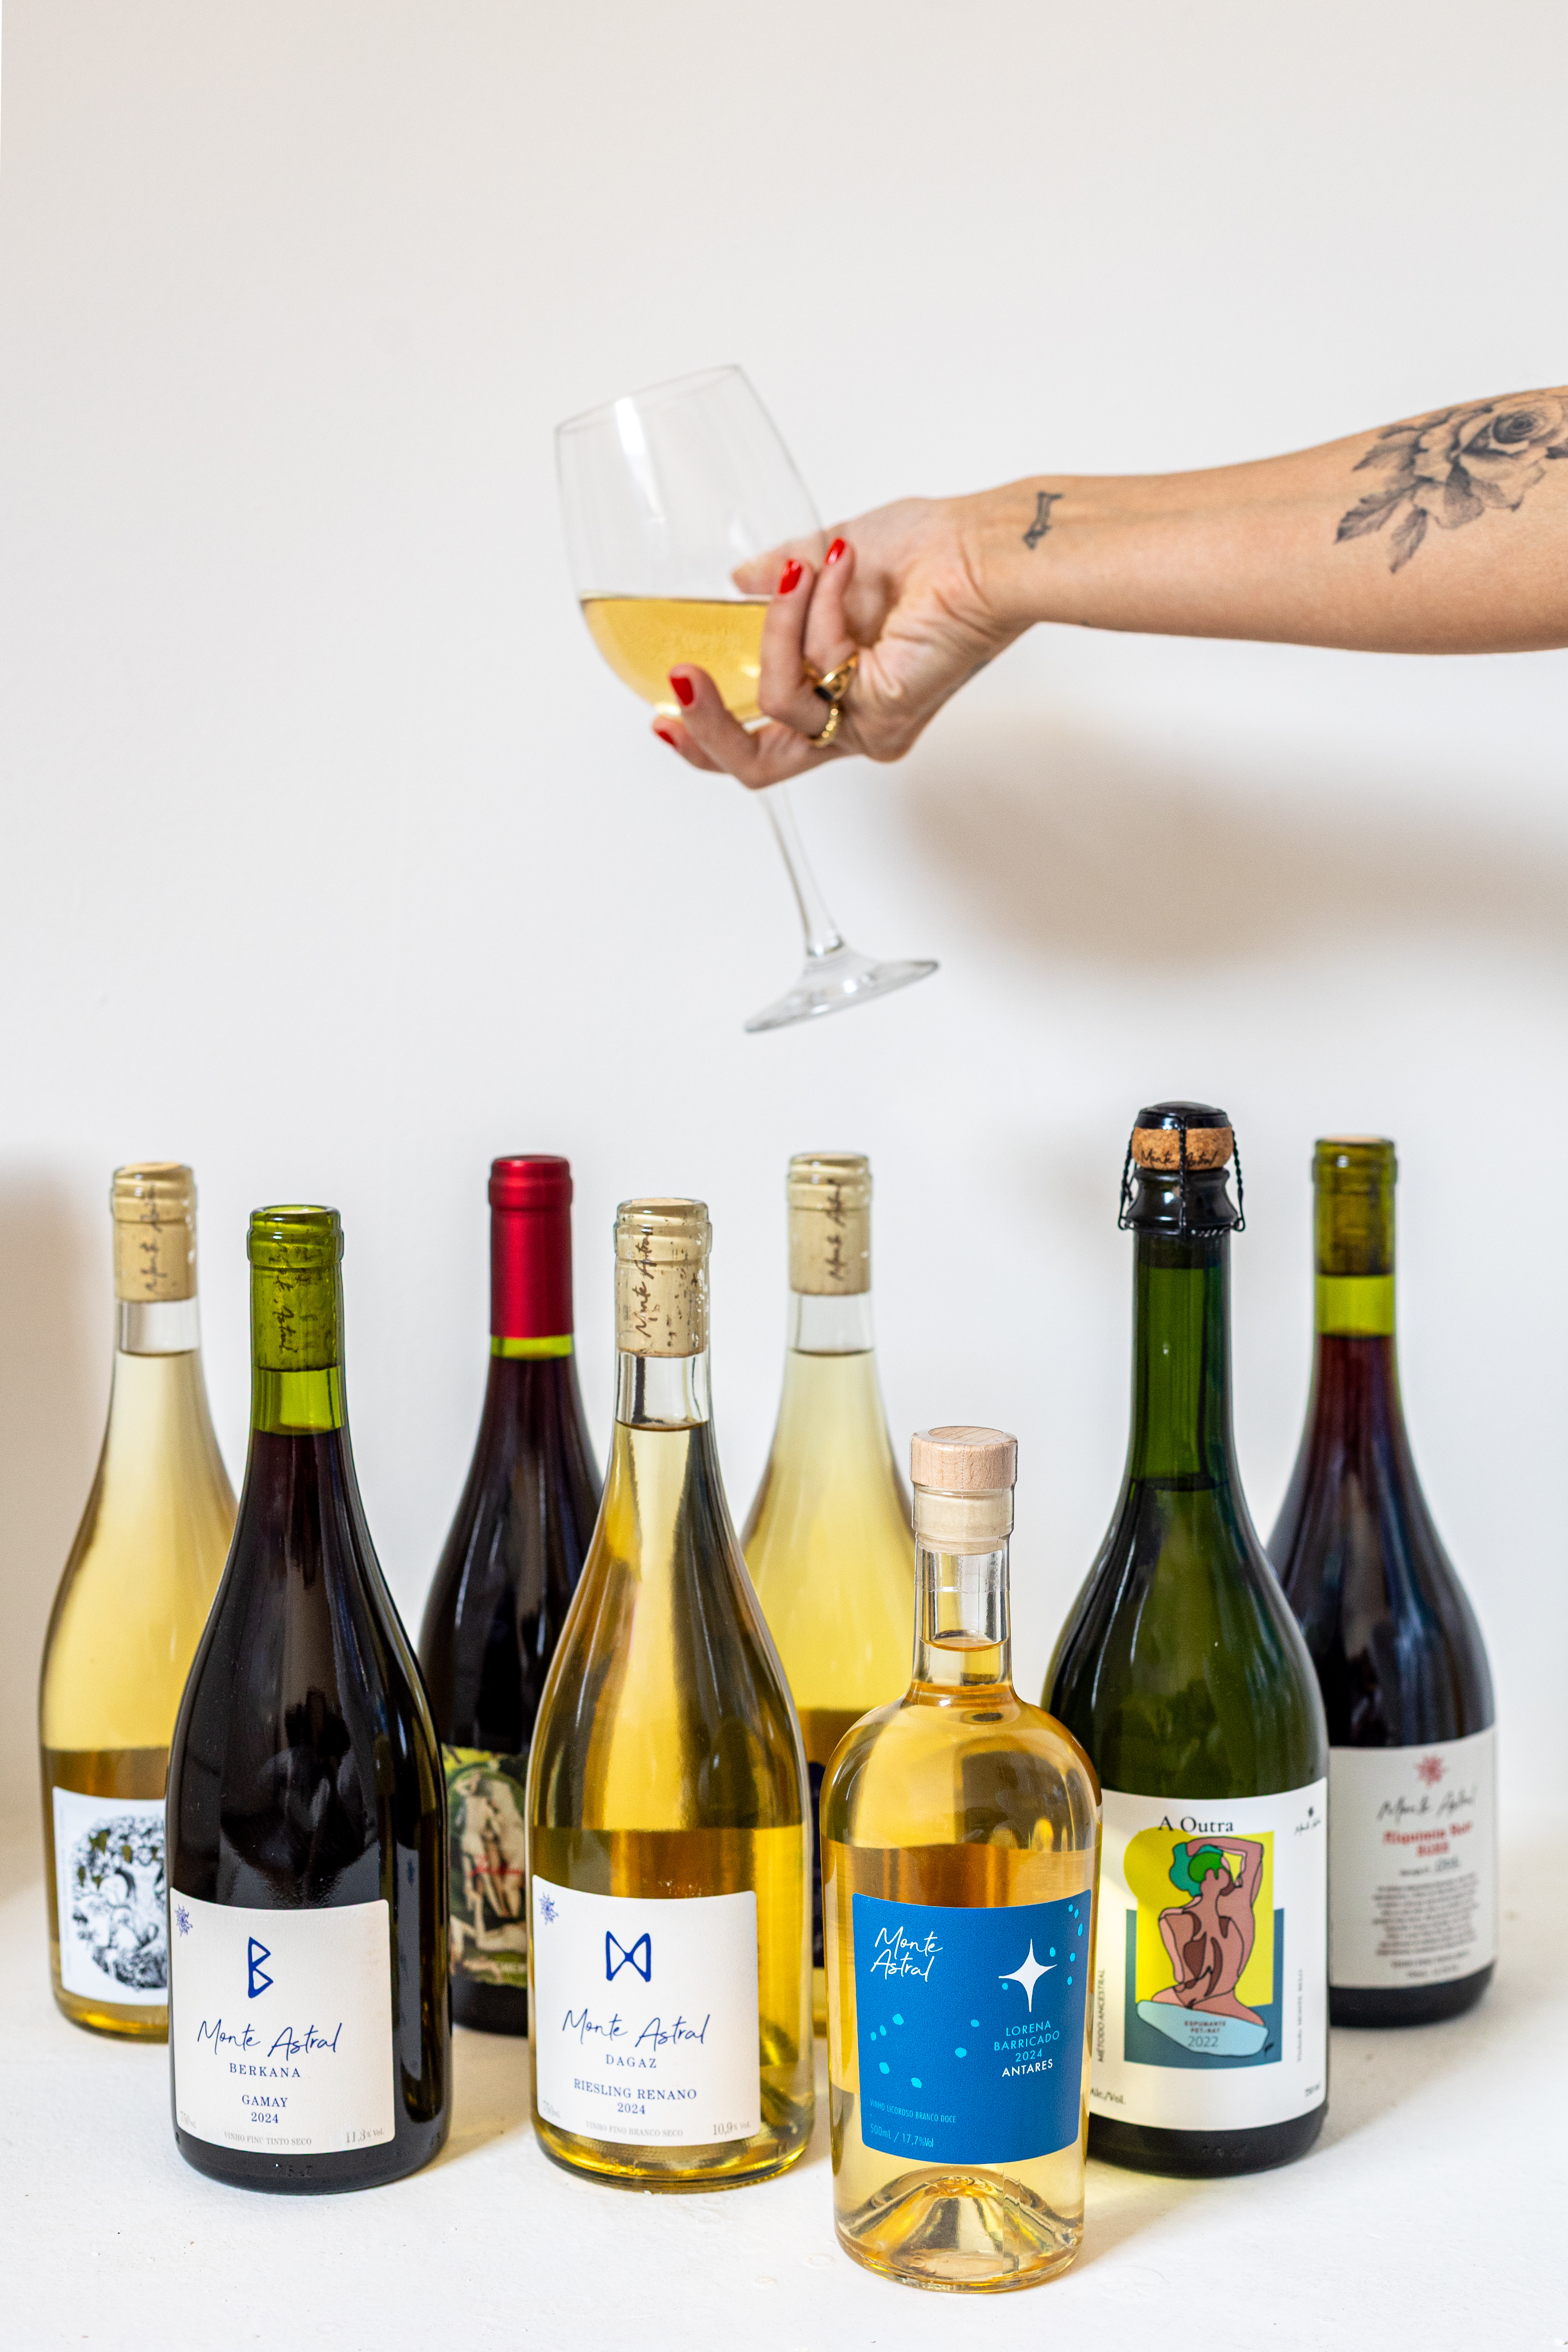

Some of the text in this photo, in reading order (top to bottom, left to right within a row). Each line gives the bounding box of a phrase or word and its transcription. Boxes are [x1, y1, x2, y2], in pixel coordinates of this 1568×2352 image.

[632, 1281, 658, 1338] Monte
[1158, 1815, 1233, 1832] A Outra
[875, 1926, 943, 1960] Monte
[870, 1949, 934, 1982] Astral
[563, 2008, 710, 2052] Monte Astral
[1006, 2020, 1051, 2037] LORENA
[197, 2019, 342, 2061] Monte Astral
[994, 2030, 1060, 2051] BARRICADO
[1187, 2035, 1219, 2048] 2022
[606, 2054, 657, 2068] DAGAZ
[1015, 2048, 1042, 2062] 2024
[230, 2062, 301, 2078] BERKANA
[1001, 2058, 1053, 2077] ANTARES
[574, 2078, 697, 2100] RIESLING RENANO
[242, 2095, 288, 2107] GAMAY
[617, 2102, 646, 2115] 2024
[251, 2112, 279, 2124] 2024
[870, 2098, 956, 2123] VINHO LICOROSO BRANCO DOCE
[585, 2120, 607, 2132] VINHO
[609, 2125, 627, 2135] FINO
[629, 2128, 660, 2137] BRANCO
[870, 2123, 892, 2139] 500mL
[903, 2133, 934, 2148] 17,7%Vol
[224, 2132, 245, 2142] VINHO
[266, 2137, 289, 2145] TINTO
